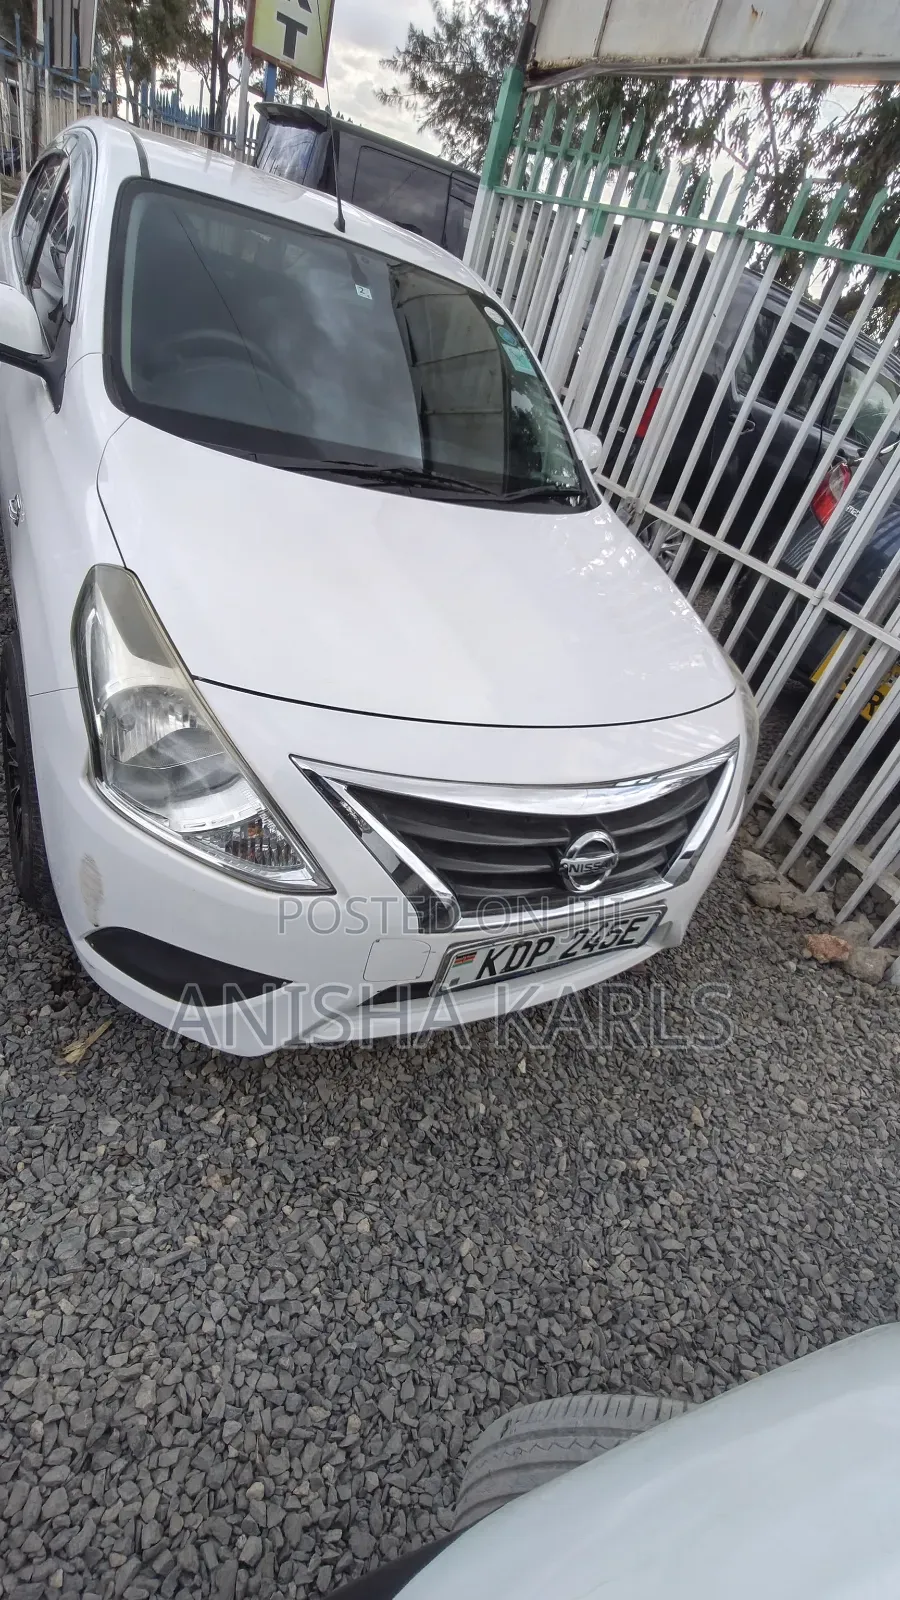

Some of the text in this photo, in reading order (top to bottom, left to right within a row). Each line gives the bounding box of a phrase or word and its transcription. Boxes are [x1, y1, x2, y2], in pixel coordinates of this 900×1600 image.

[568, 859, 614, 873] NISSAN
[475, 916, 650, 980] KDP 245E
